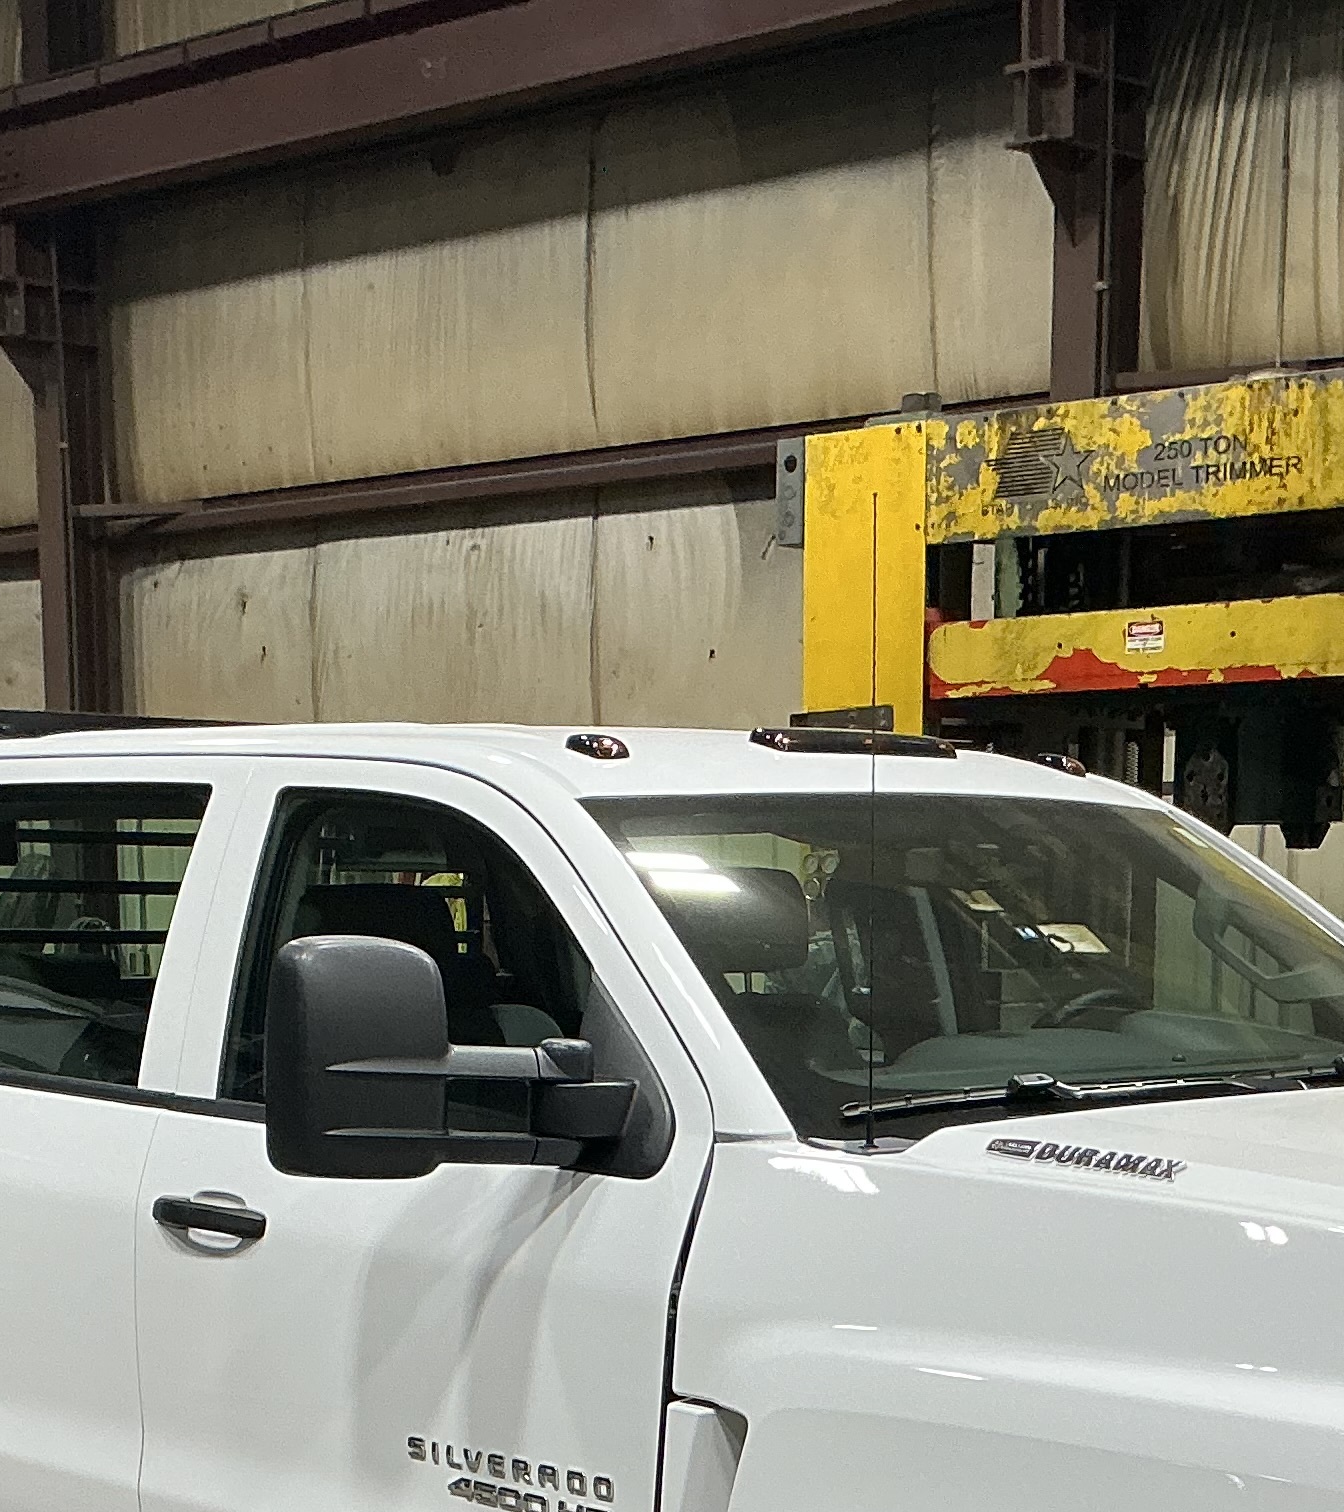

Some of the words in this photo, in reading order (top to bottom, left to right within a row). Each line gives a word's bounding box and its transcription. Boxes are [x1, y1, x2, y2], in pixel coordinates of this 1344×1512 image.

[1154, 439, 1193, 461] 250
[1199, 434, 1249, 456] TON
[1102, 467, 1184, 493] MODEL
[1189, 455, 1303, 485] TRIMMER
[1034, 1142, 1187, 1183] DURAMAX
[407, 1435, 615, 1503] SILVERADO
